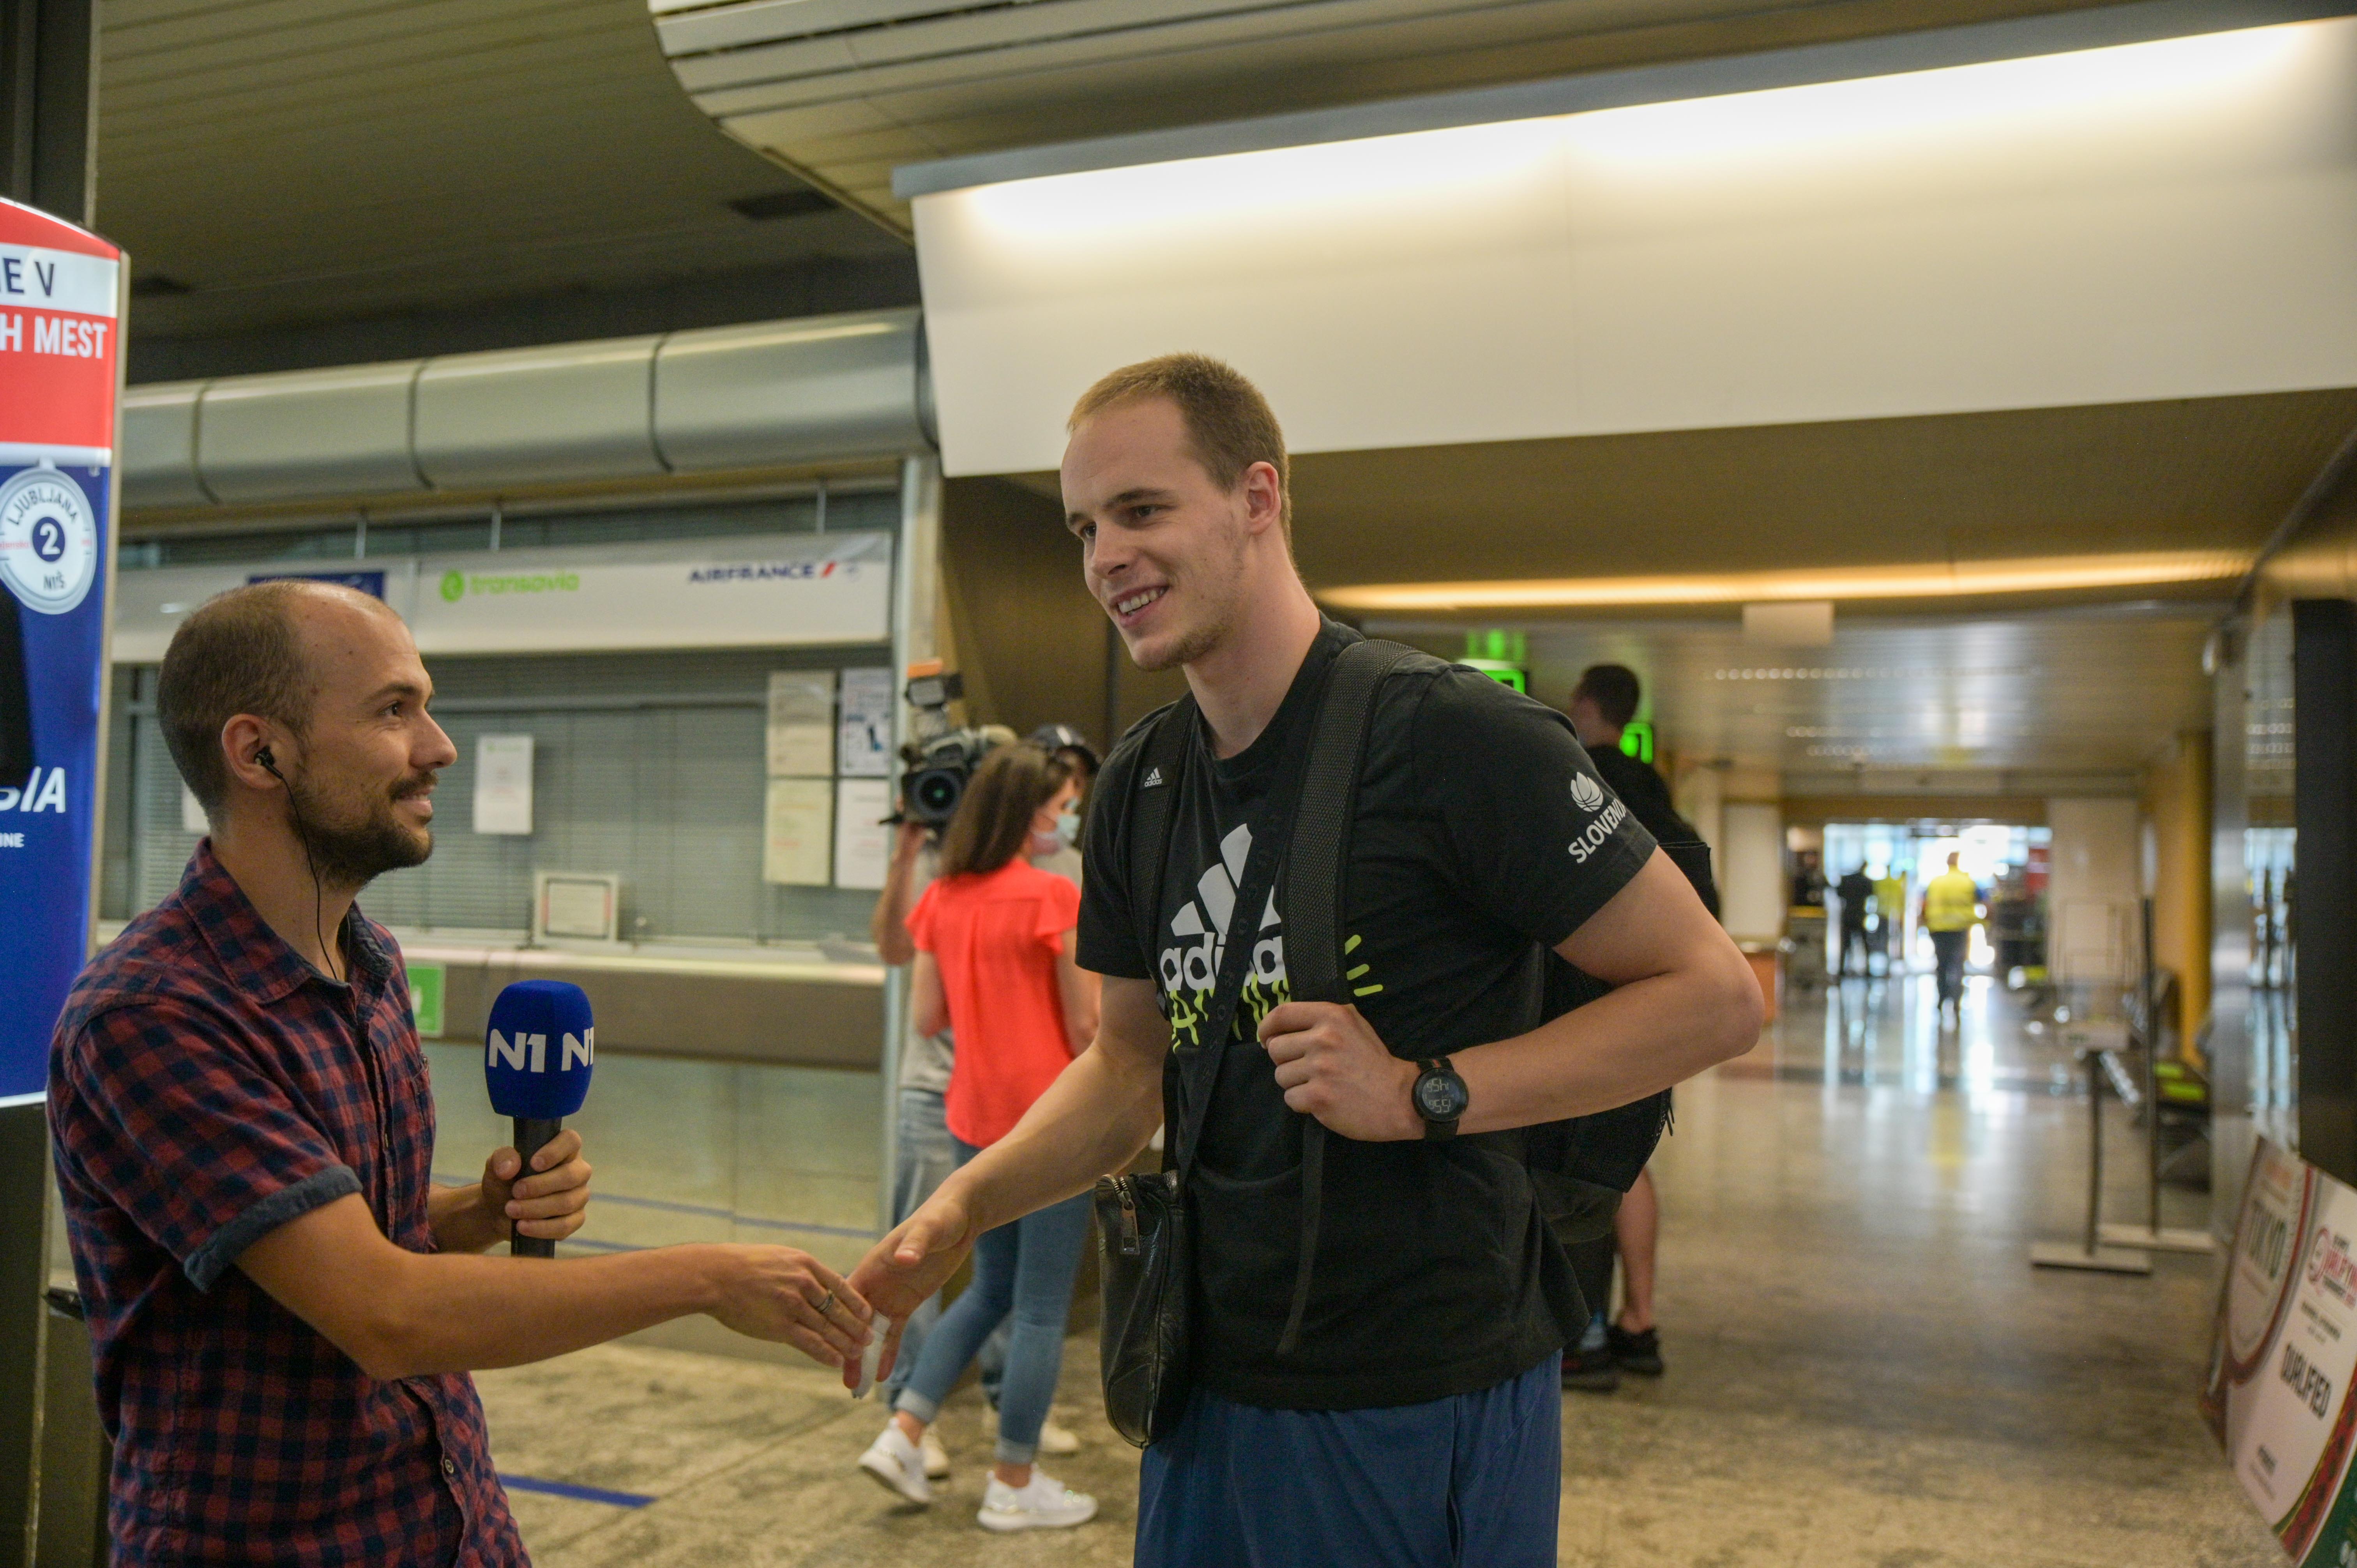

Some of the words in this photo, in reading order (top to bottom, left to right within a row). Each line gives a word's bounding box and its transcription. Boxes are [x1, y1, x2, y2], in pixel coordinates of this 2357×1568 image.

[0, 257, 24, 294] E
[34, 261, 54, 297] V
[34, 315, 108, 359] MEST
[6, 488, 78, 526] LJUBLJANA
[39, 522, 60, 555] 2
[44, 570, 65, 589] NIŠ
[1144, 778, 1162, 787] adidas
[488, 1028, 546, 1073] N1
